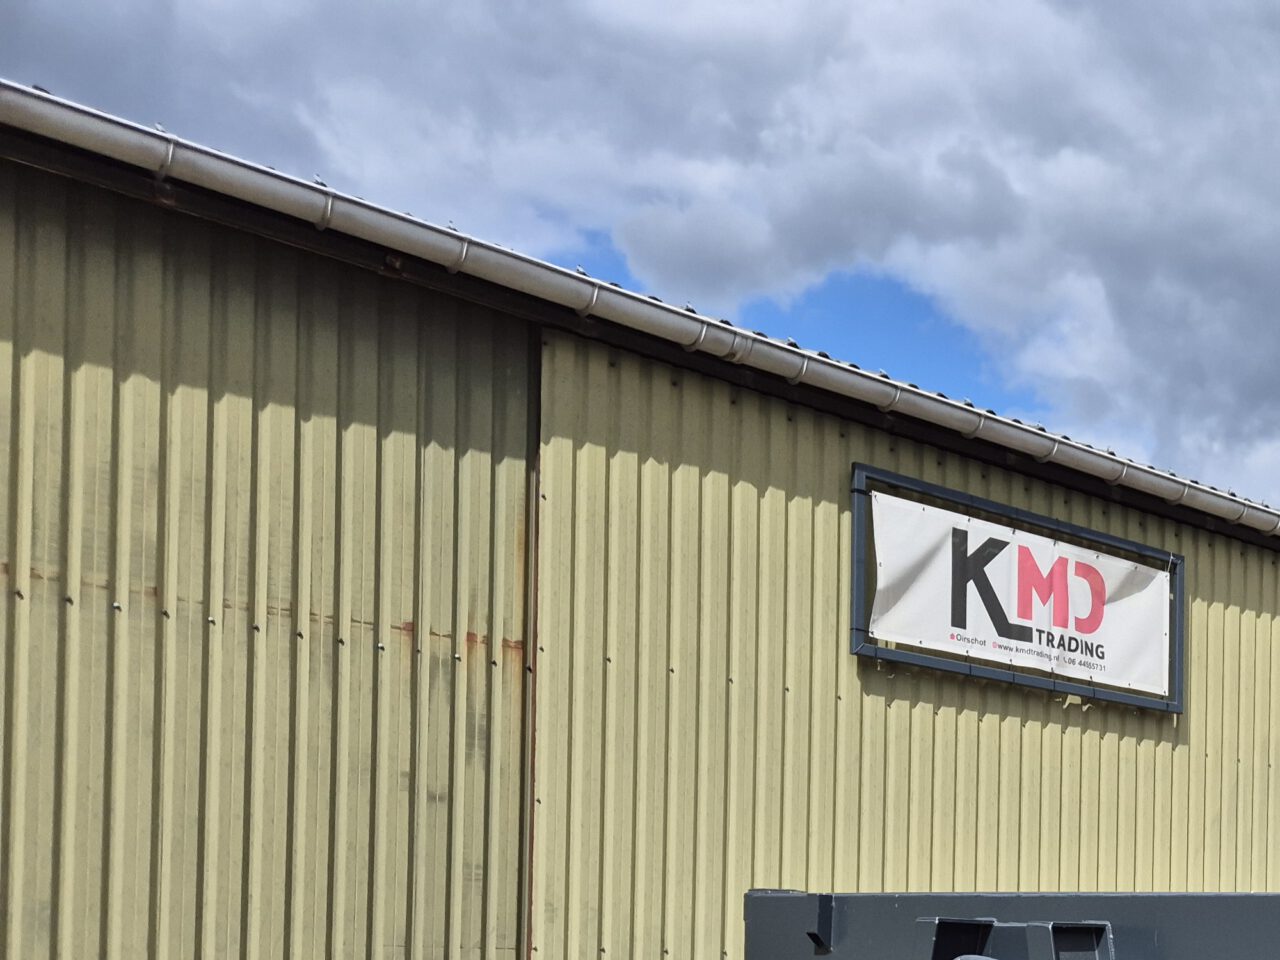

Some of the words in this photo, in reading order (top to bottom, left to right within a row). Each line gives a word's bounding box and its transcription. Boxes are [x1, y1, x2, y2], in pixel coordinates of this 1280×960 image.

[951, 527, 1106, 643] KMD
[956, 633, 986, 647] Oirschot
[1067, 657, 1077, 666] 06
[1035, 629, 1105, 660] TRADING
